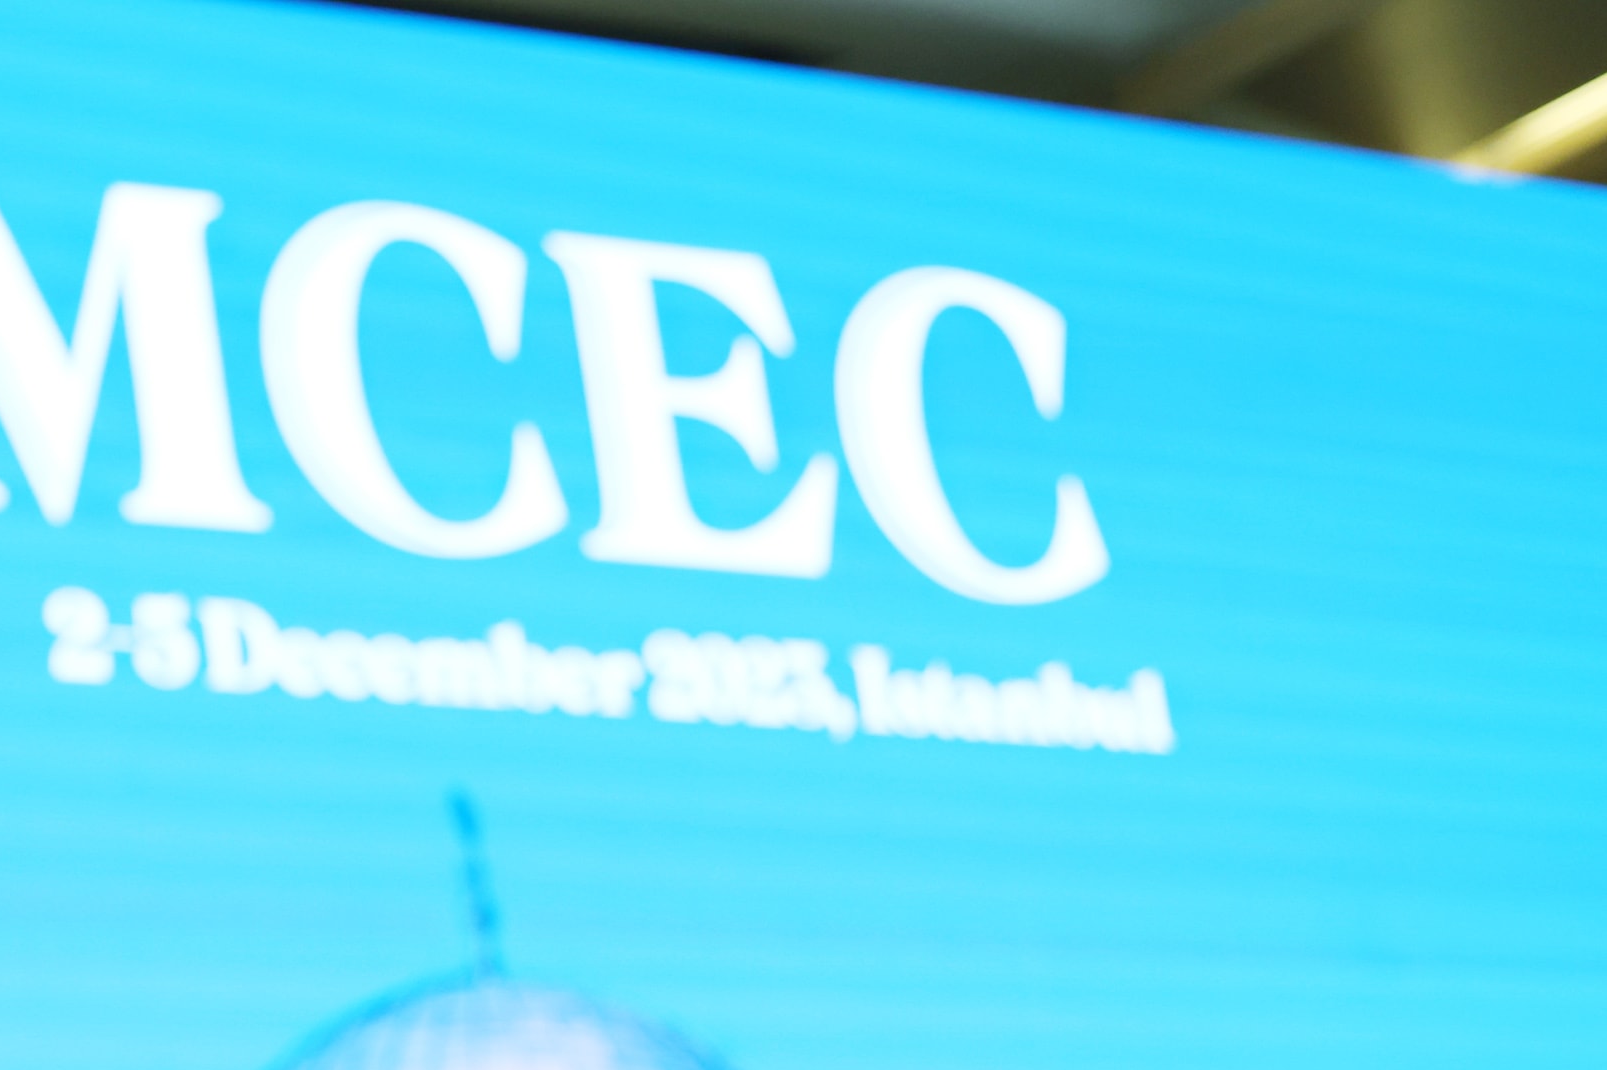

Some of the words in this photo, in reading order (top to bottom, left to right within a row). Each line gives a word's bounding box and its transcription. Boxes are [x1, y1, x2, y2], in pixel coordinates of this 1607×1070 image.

[43, 588, 199, 689] 2-5
[199, 598, 644, 717] December
[852, 646, 1173, 753] Istanbul
